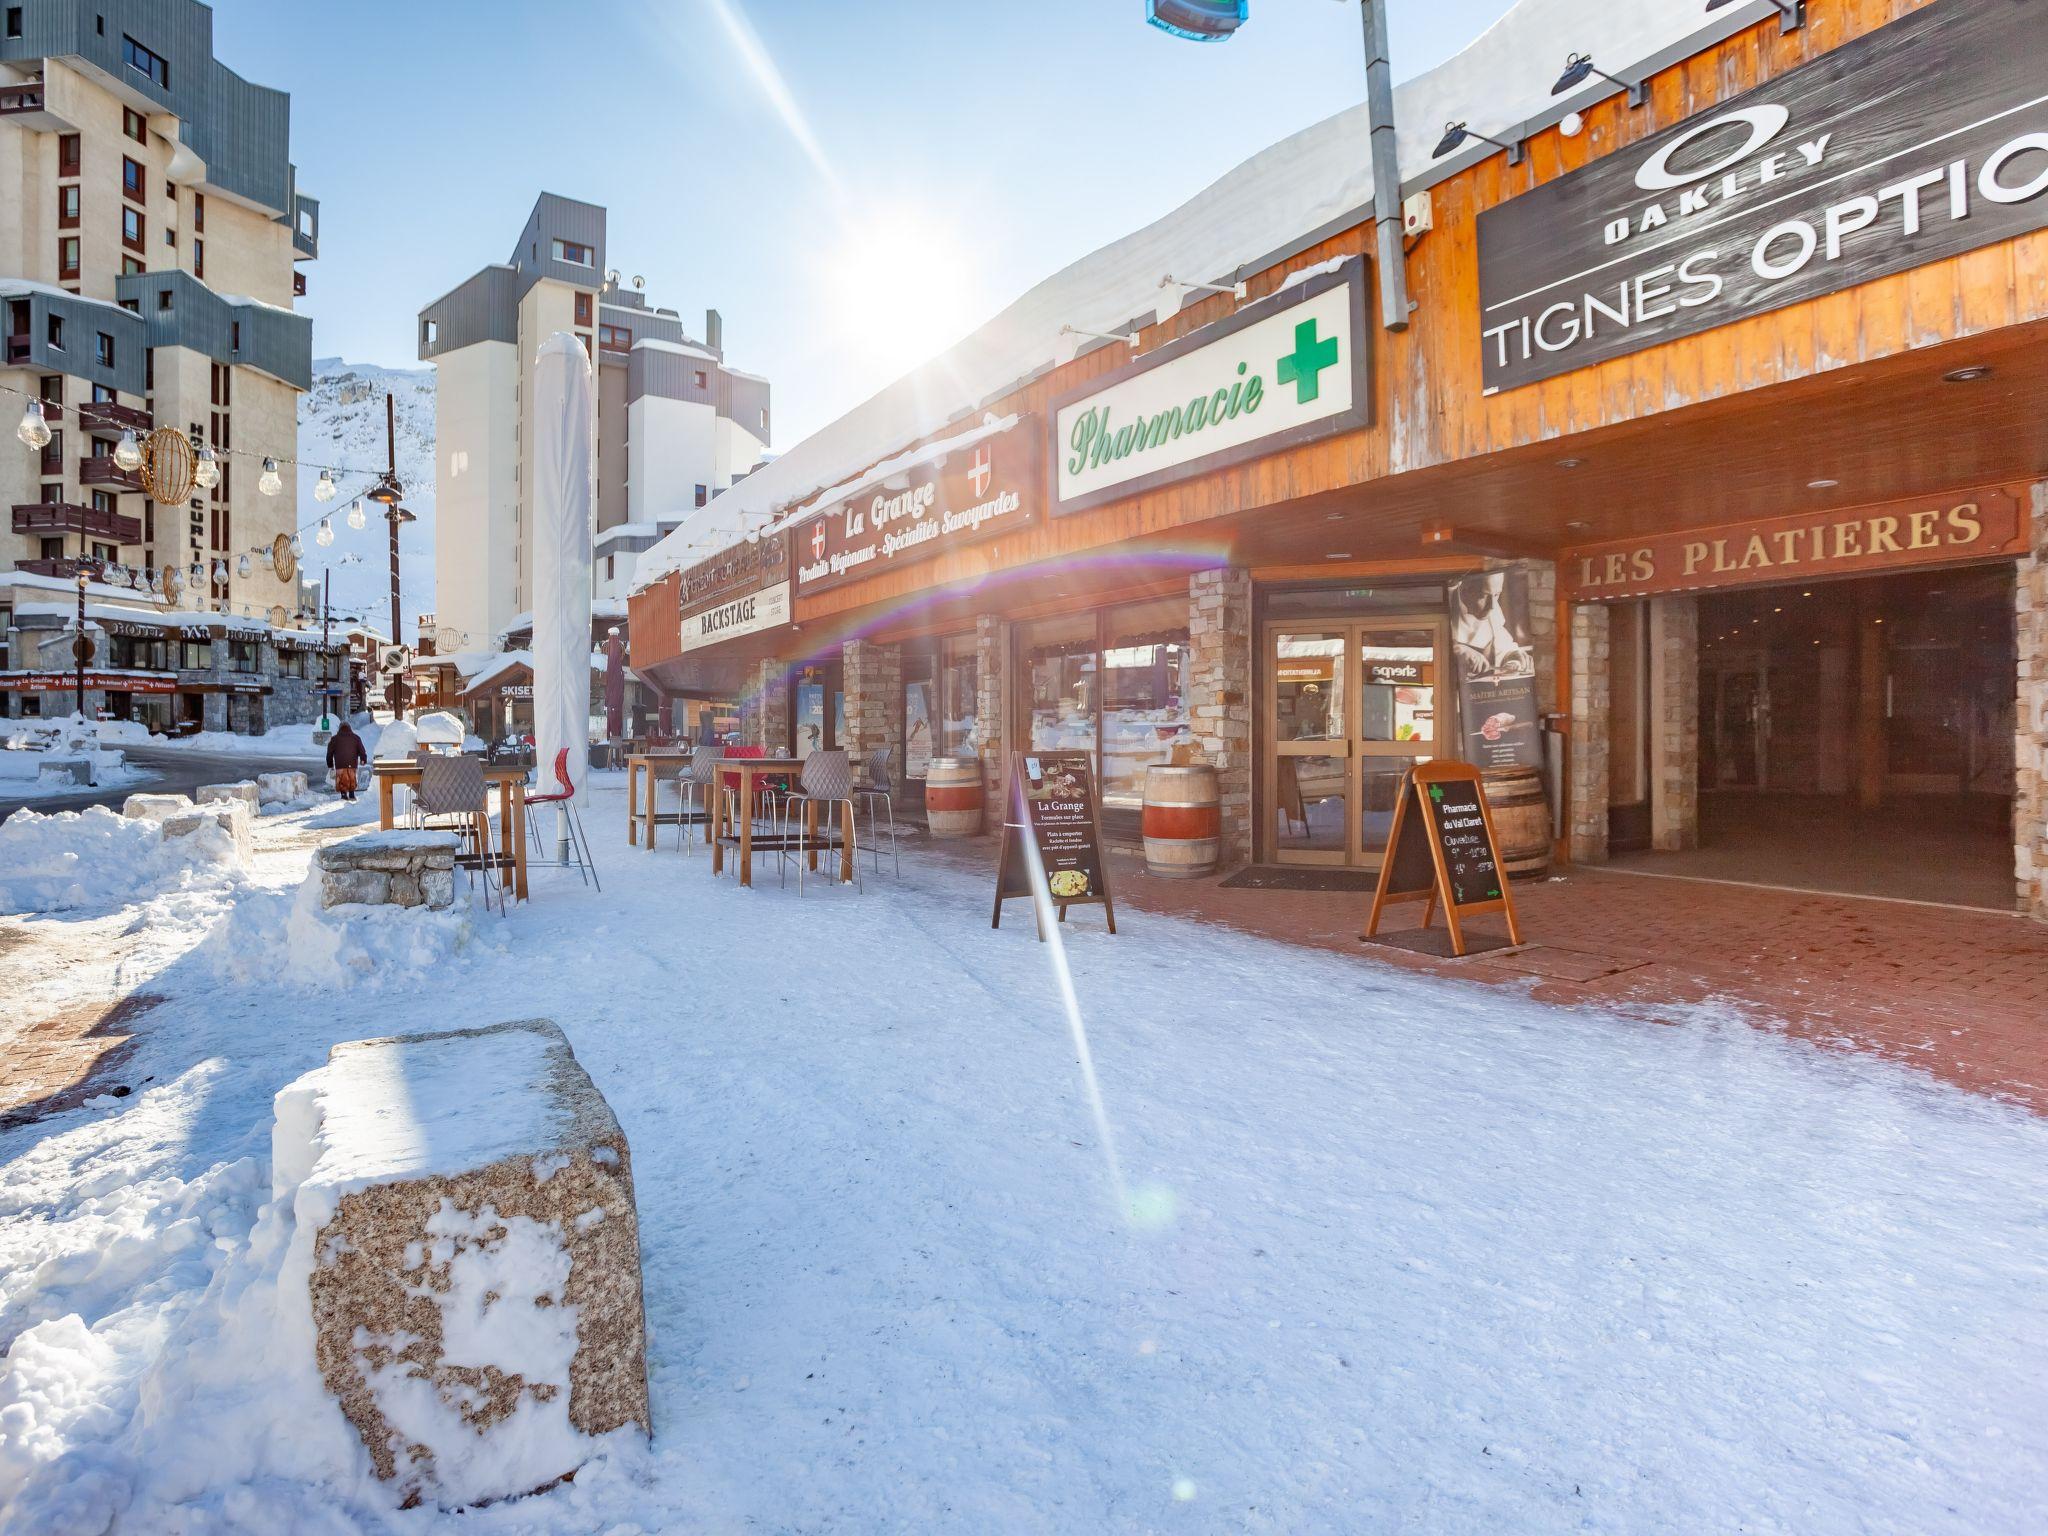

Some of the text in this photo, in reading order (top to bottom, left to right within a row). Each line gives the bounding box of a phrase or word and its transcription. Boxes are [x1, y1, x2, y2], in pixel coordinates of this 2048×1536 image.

[1604, 133, 1832, 246] OAKLEY
[1483, 251, 1723, 369] TIGNES
[1068, 361, 1264, 475] Pharmacie
[799, 560, 830, 584] Produits
[830, 544, 877, 575] Régionaux
[882, 518, 940, 558] Spécialités
[942, 490, 1020, 535] Savoyardes
[845, 482, 936, 538] La Grange
[1580, 503, 1983, 588] LES PLATIERES
[179, 625, 211, 639] BAR
[701, 597, 756, 635] BACKSTAGE
[1038, 801, 1084, 812] La Grange
[1442, 803, 1478, 814] Pharmacie
[1444, 817, 1483, 829] du Val Claret
